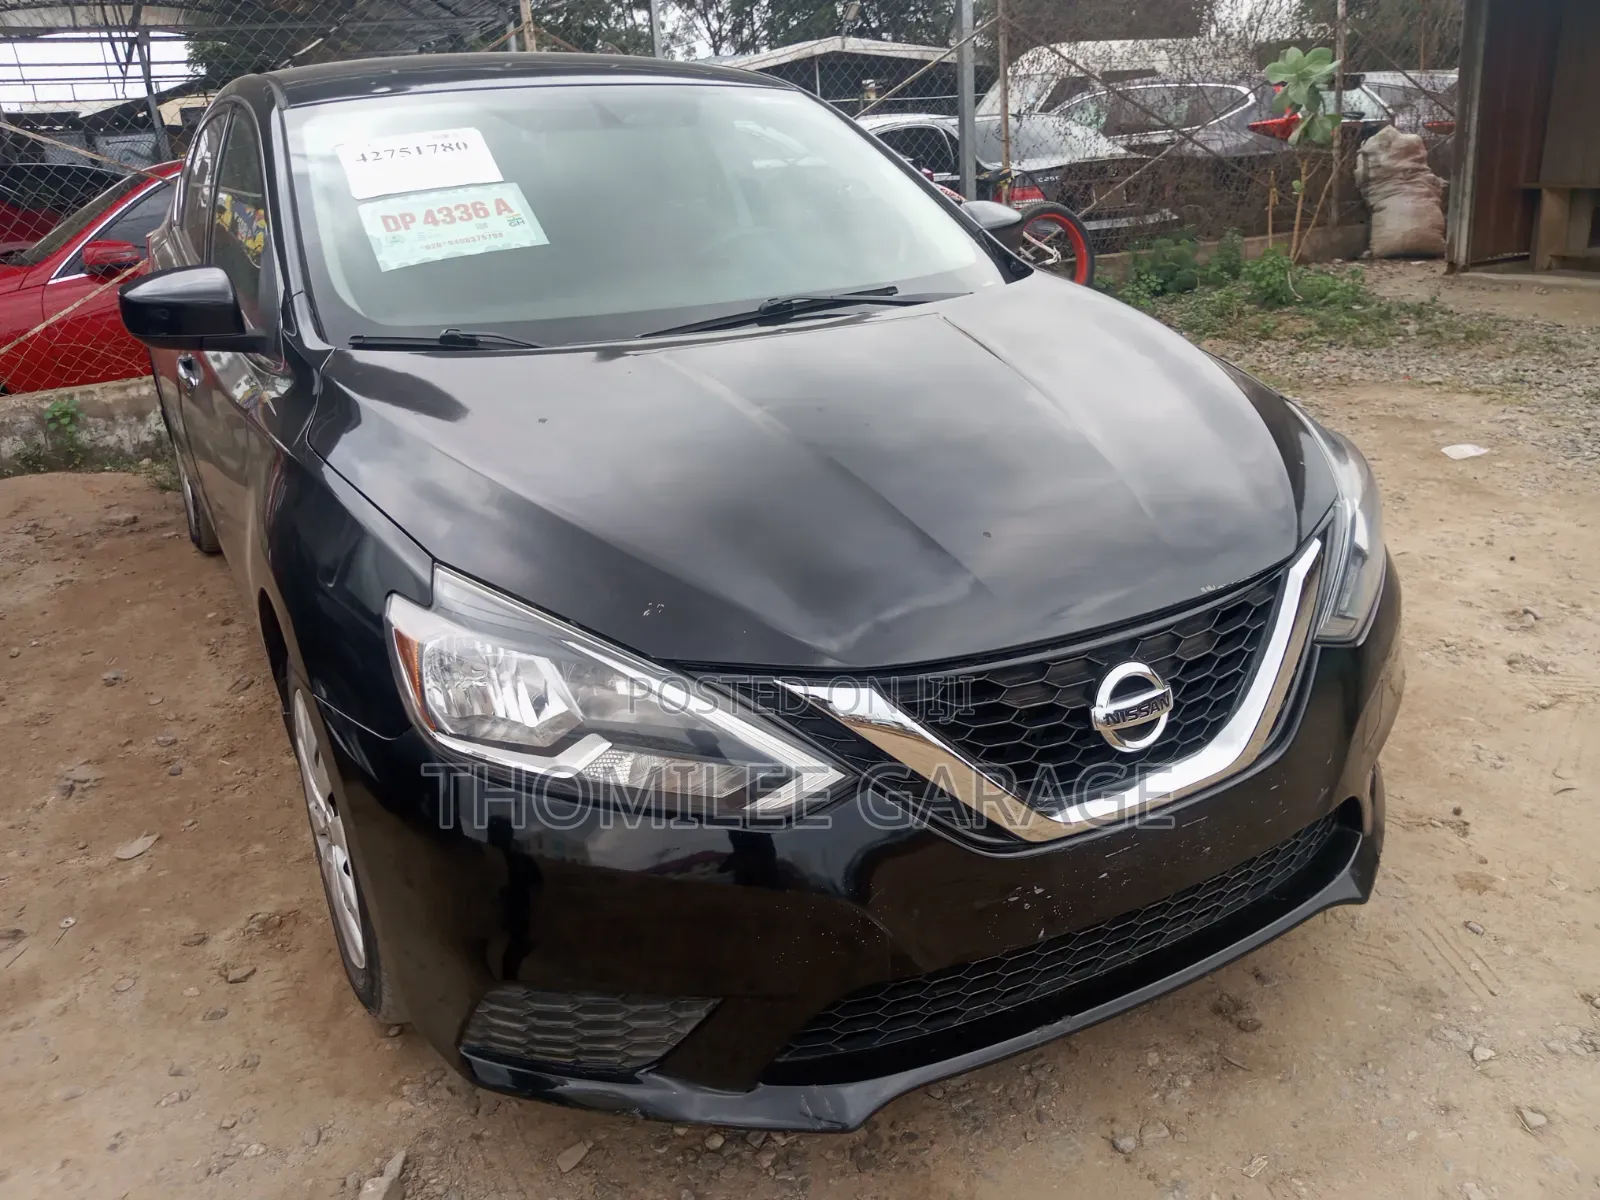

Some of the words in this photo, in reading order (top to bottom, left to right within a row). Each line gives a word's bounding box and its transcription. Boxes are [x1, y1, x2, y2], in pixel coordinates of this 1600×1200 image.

[355, 141, 469, 163] 42751780
[380, 211, 417, 233] DP
[422, 201, 490, 227] 4336
[495, 197, 514, 217] A
[1103, 693, 1170, 725] NISSAN
